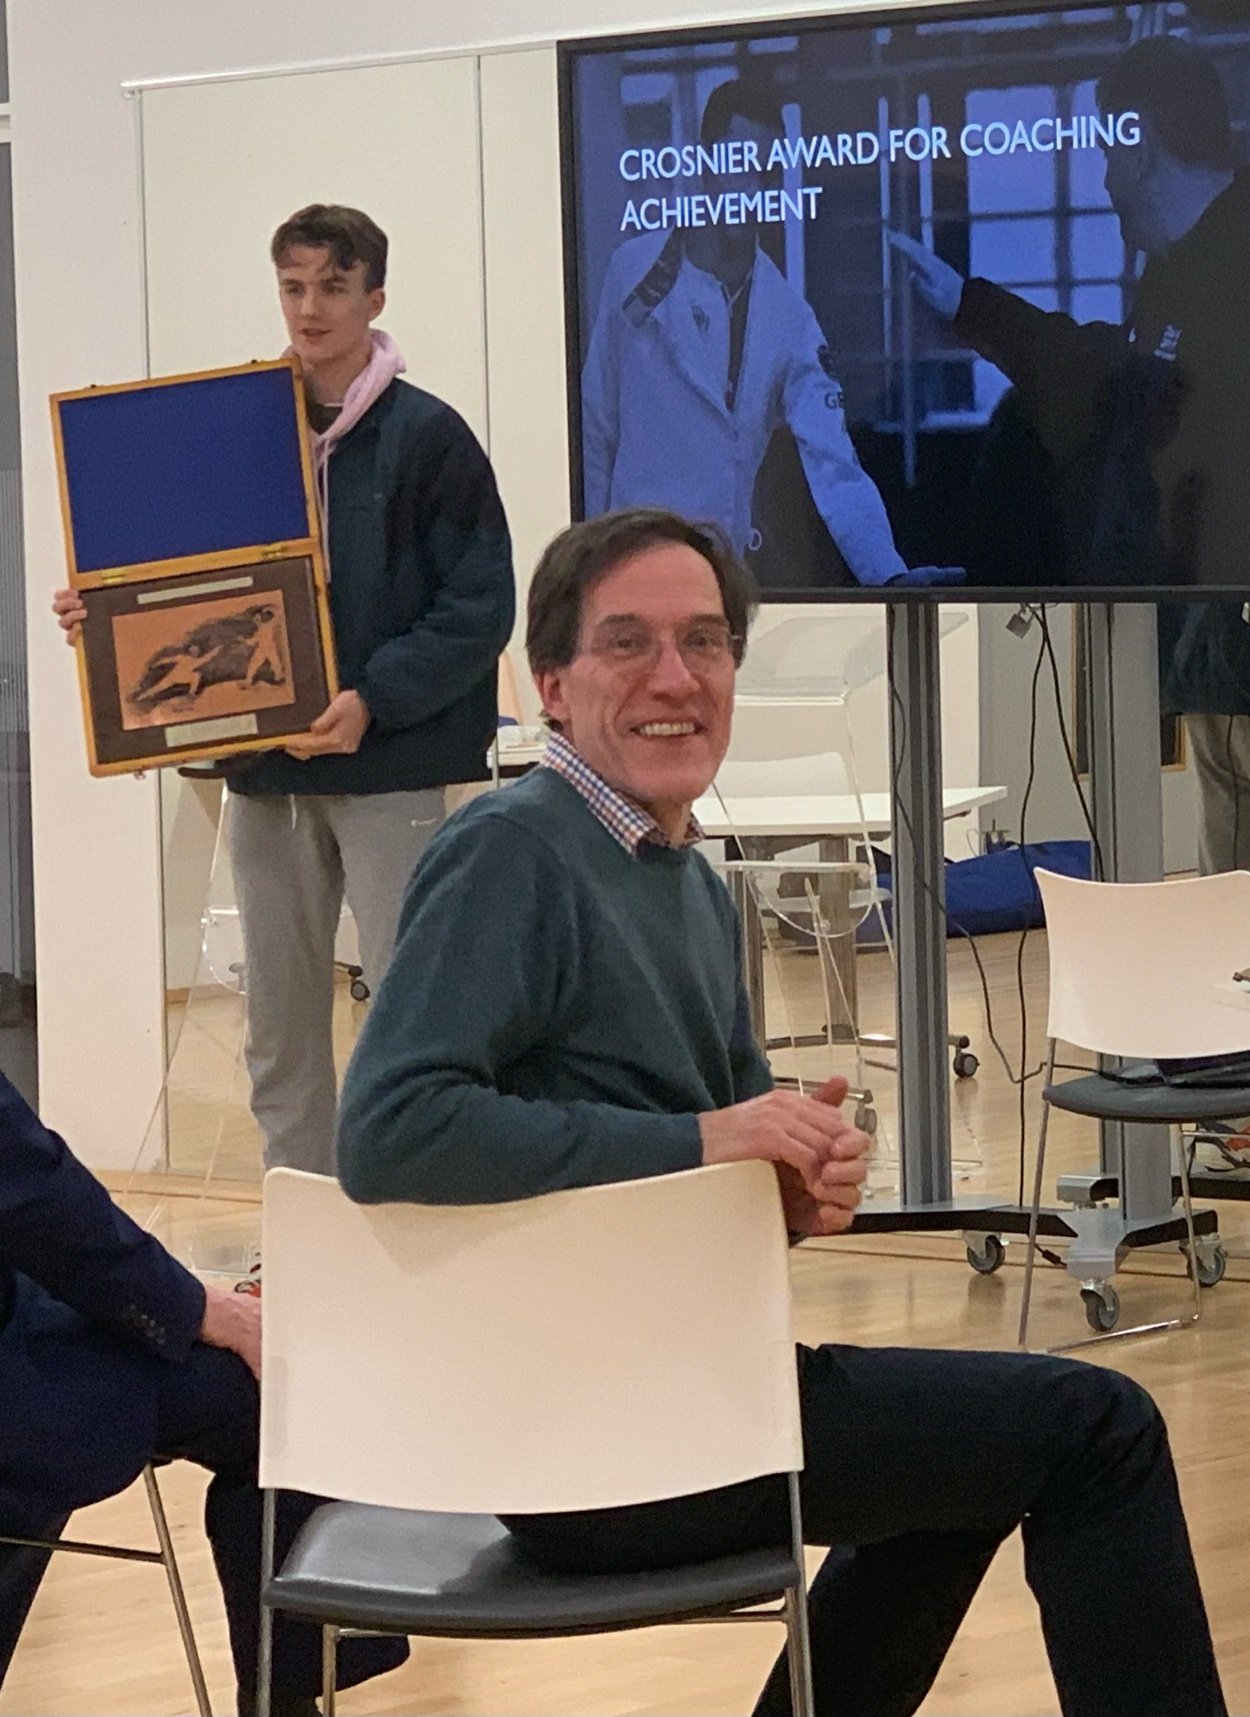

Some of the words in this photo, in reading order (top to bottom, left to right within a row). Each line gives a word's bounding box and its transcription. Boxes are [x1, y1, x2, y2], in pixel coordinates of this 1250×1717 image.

[619, 140, 760, 182] CROSNIER
[766, 131, 880, 172] AWARD
[889, 126, 952, 164] FOR
[959, 111, 1142, 157] COACHING
[620, 186, 823, 232] ACHIEVEMENT
